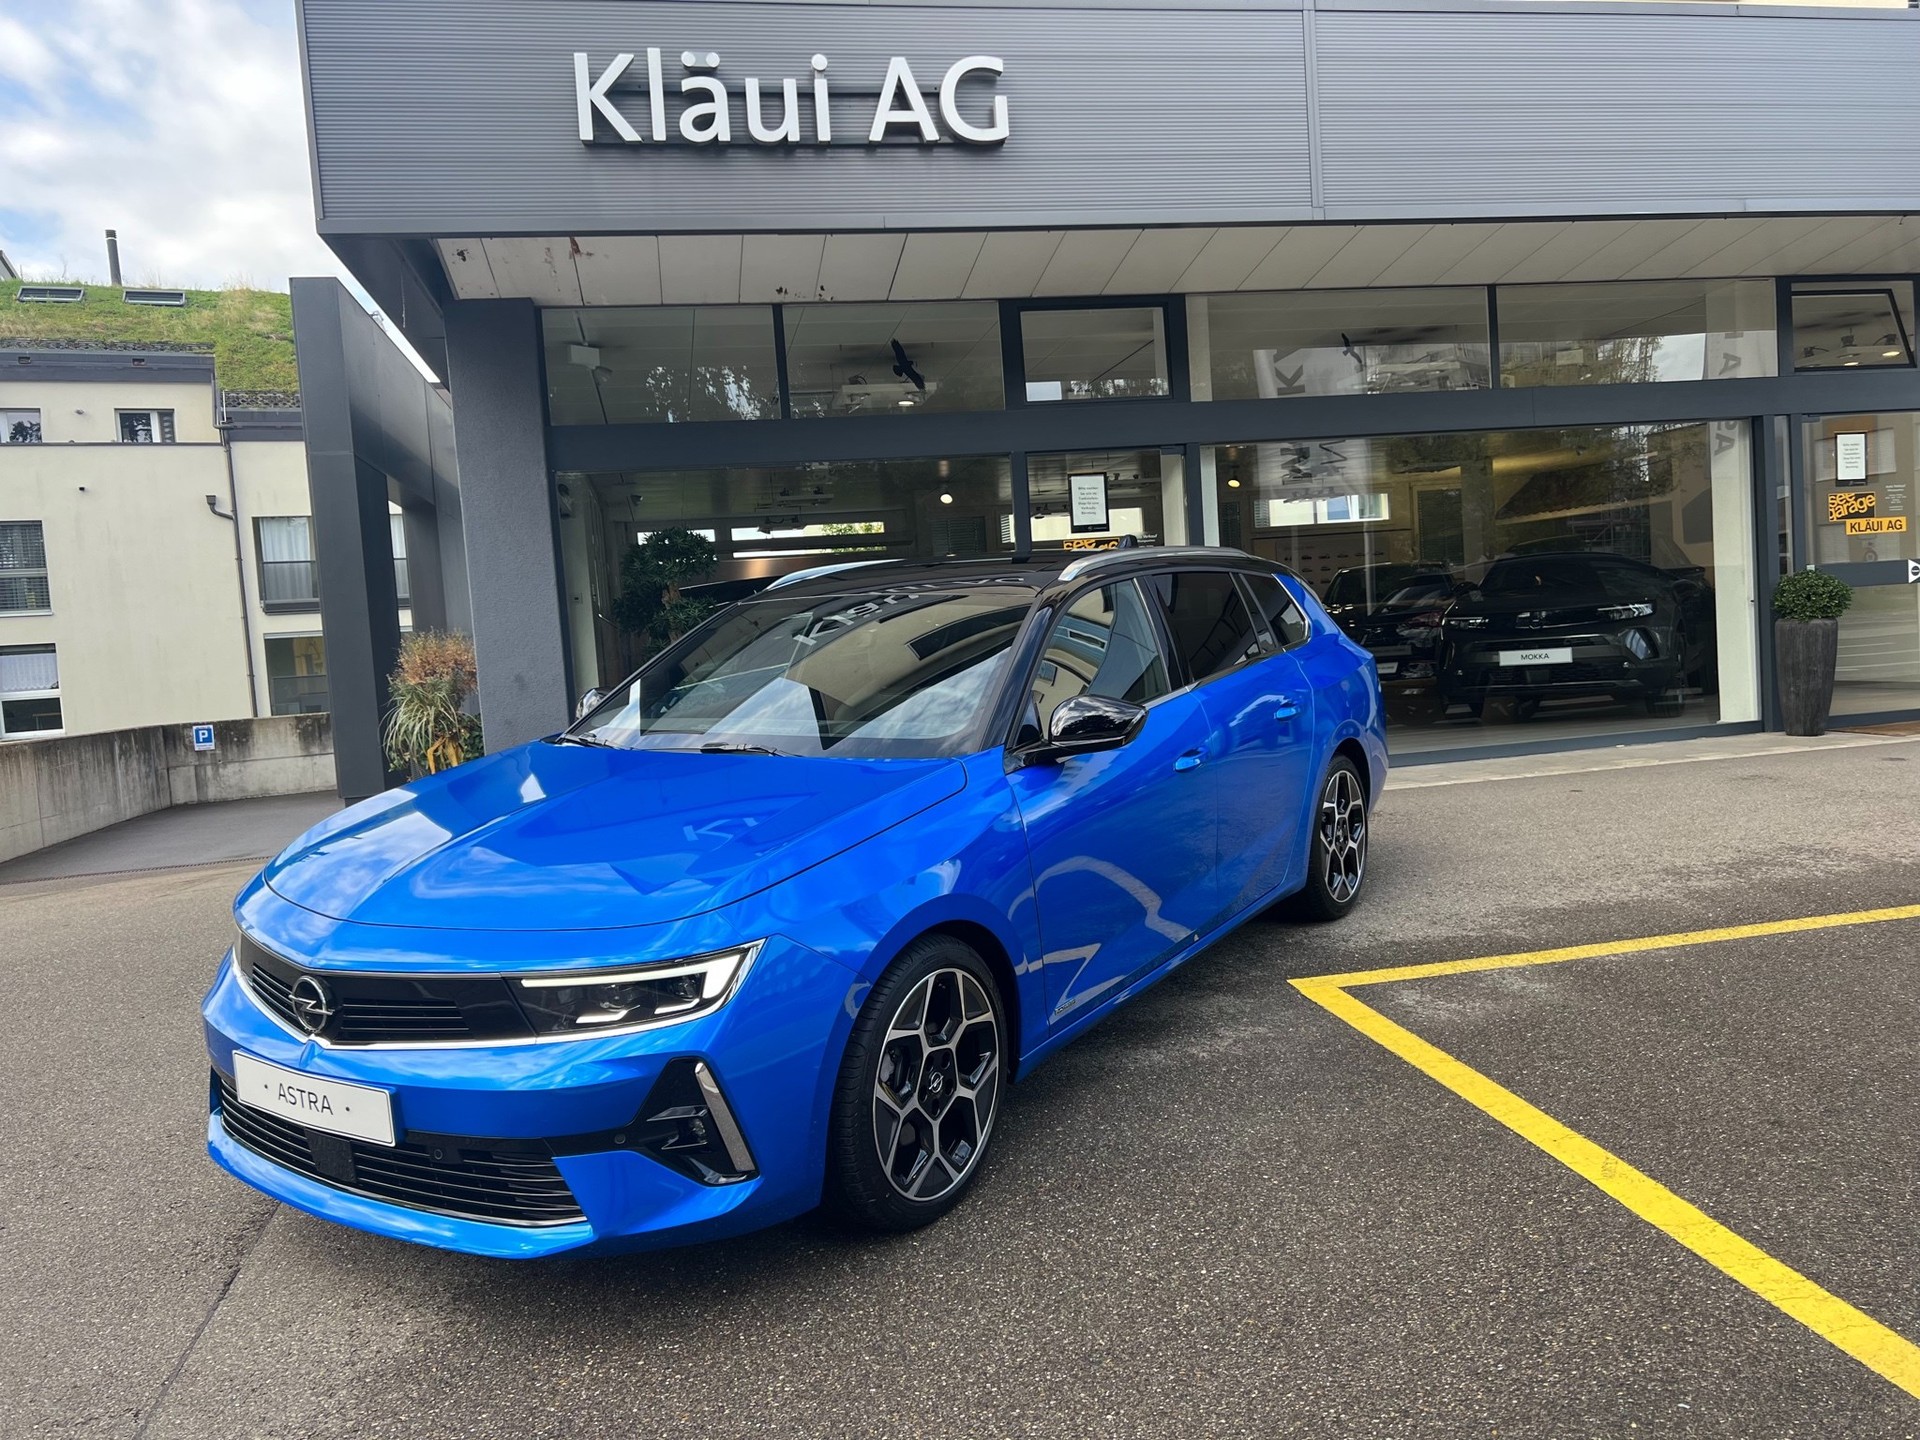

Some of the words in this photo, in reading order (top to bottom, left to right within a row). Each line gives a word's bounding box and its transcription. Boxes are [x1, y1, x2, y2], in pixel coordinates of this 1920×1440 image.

[573, 47, 832, 143] Kläui
[868, 55, 1010, 144] AG
[1850, 519, 1883, 533] KLÄUI
[1887, 519, 1903, 530] AG
[1521, 653, 1550, 661] MOKKA
[198, 730, 209, 742] P
[277, 1082, 334, 1116] ASTRA
